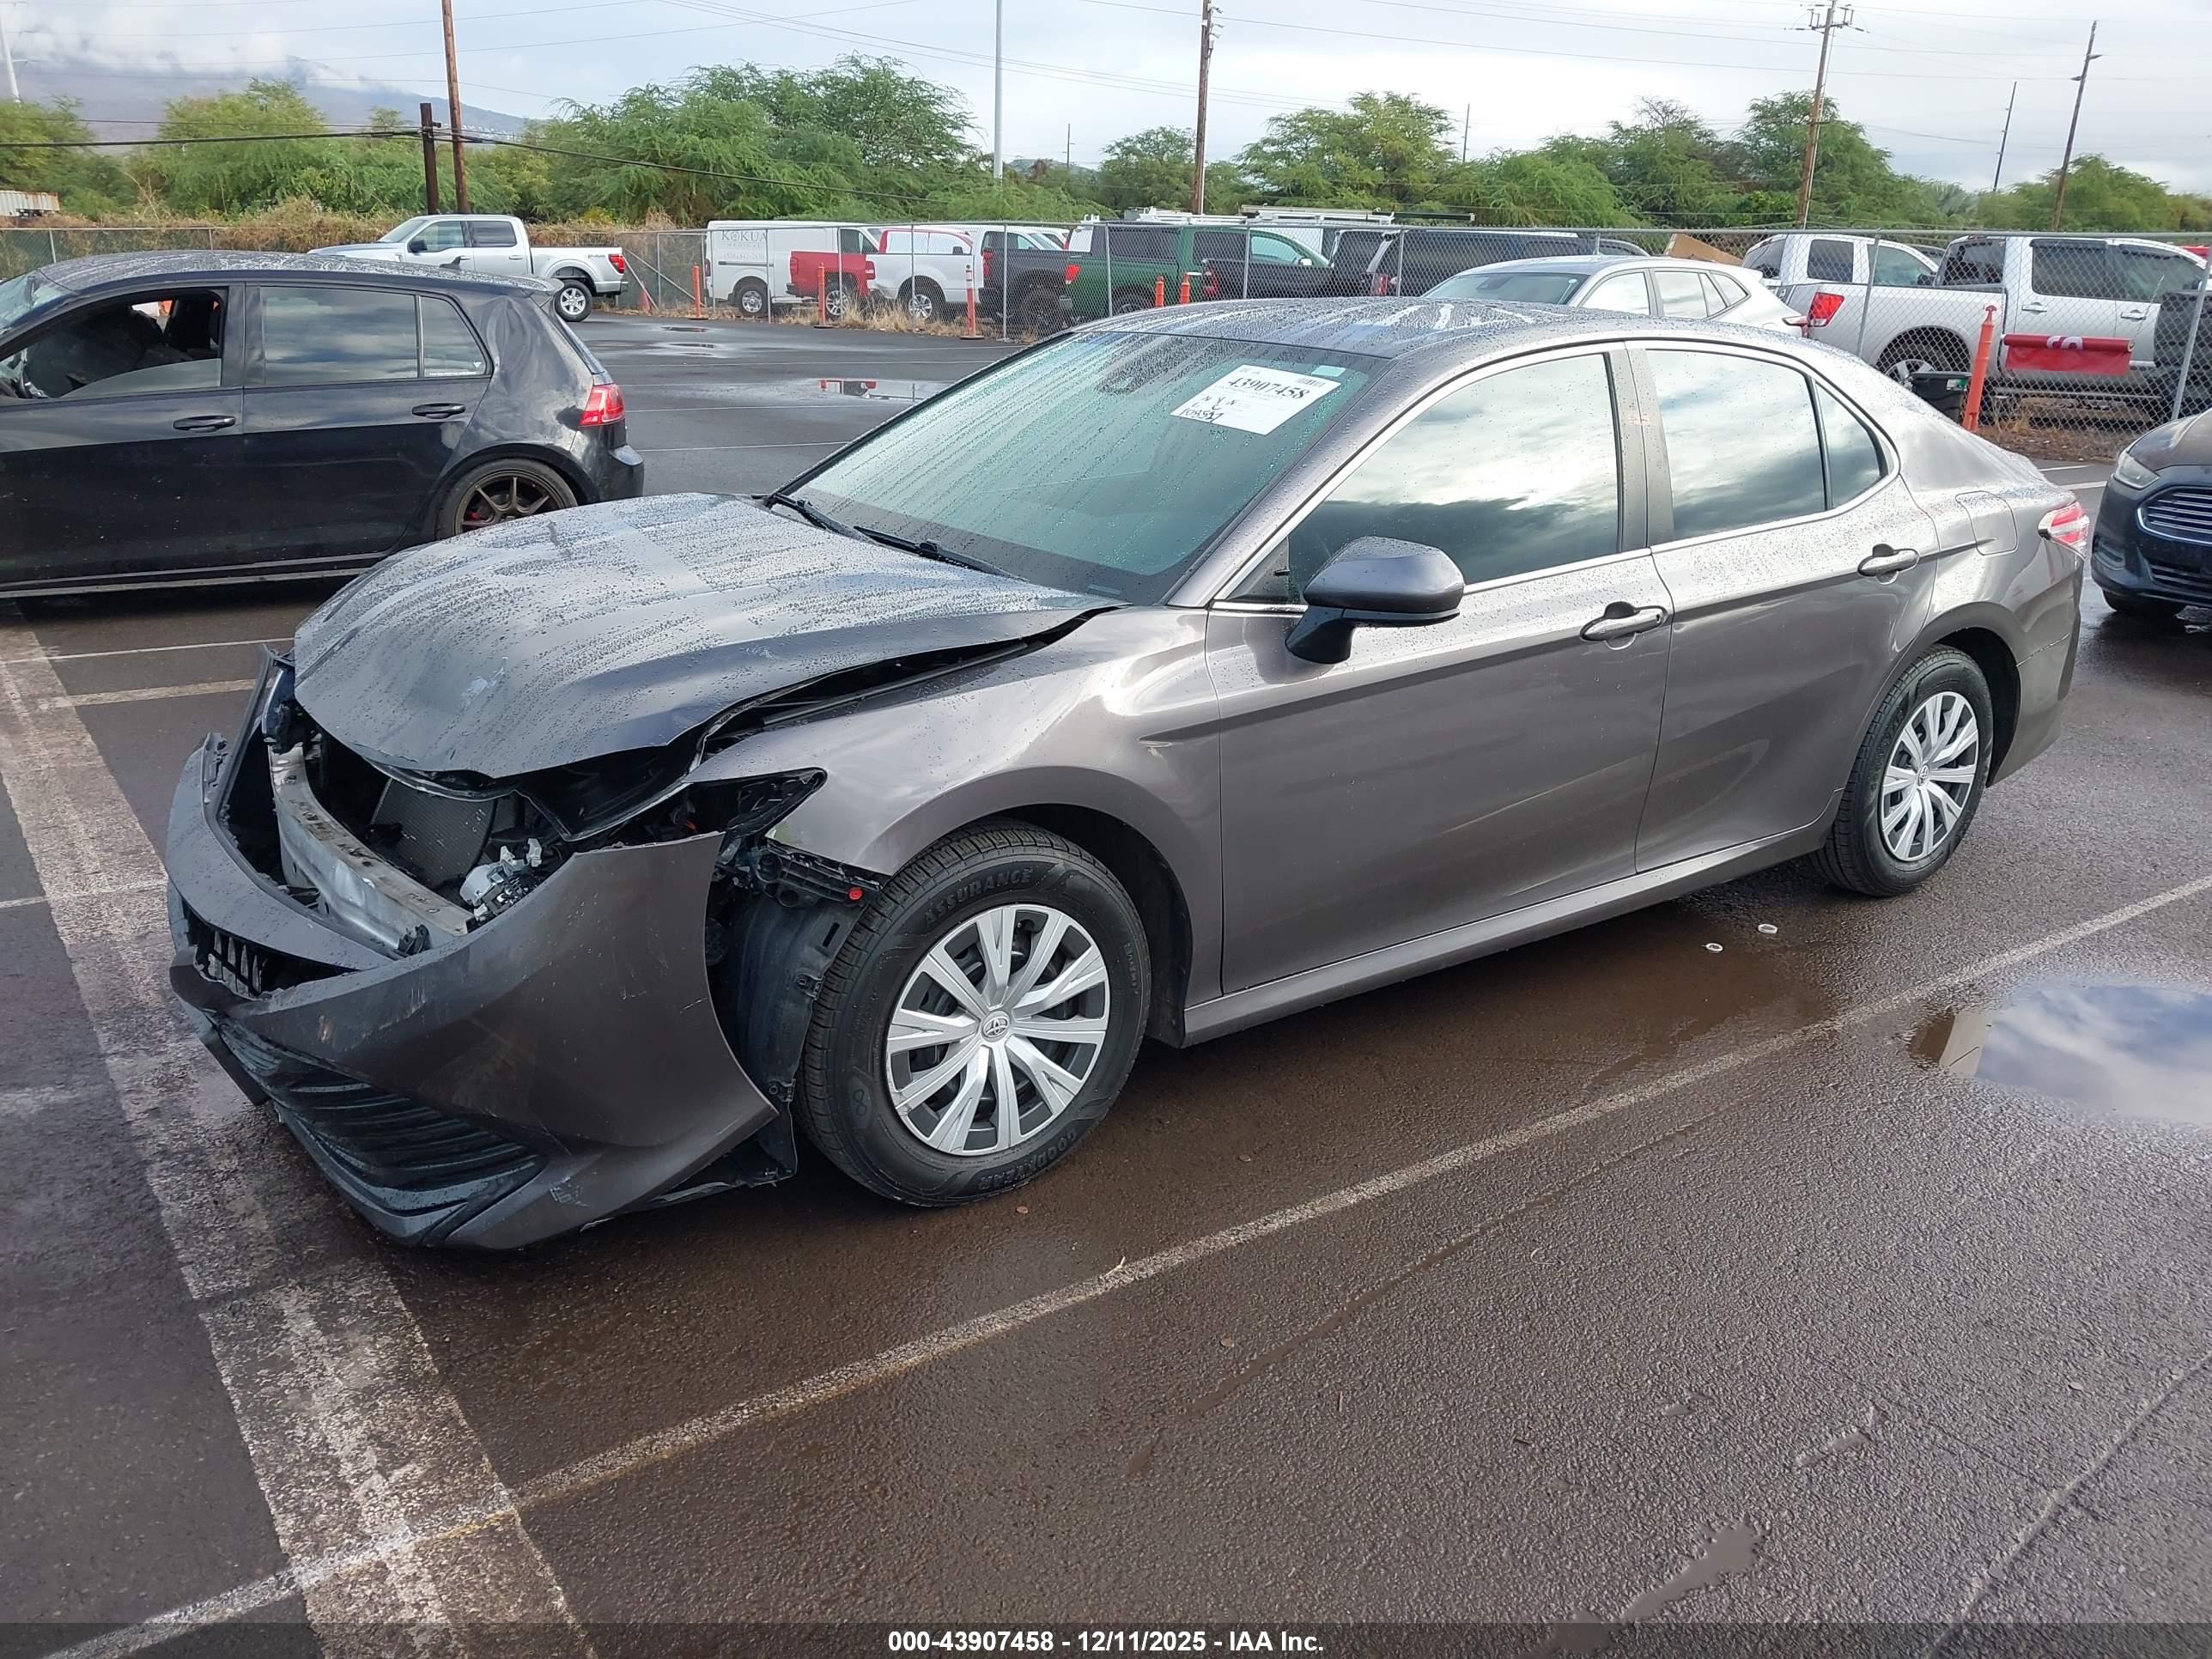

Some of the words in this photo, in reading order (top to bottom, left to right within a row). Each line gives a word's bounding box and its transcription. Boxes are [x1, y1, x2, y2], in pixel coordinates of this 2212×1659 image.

[721, 229, 767, 241] KOKUA
[1227, 377, 1310, 399] 43907458
[924, 869, 1032, 927] ASSURANCE
